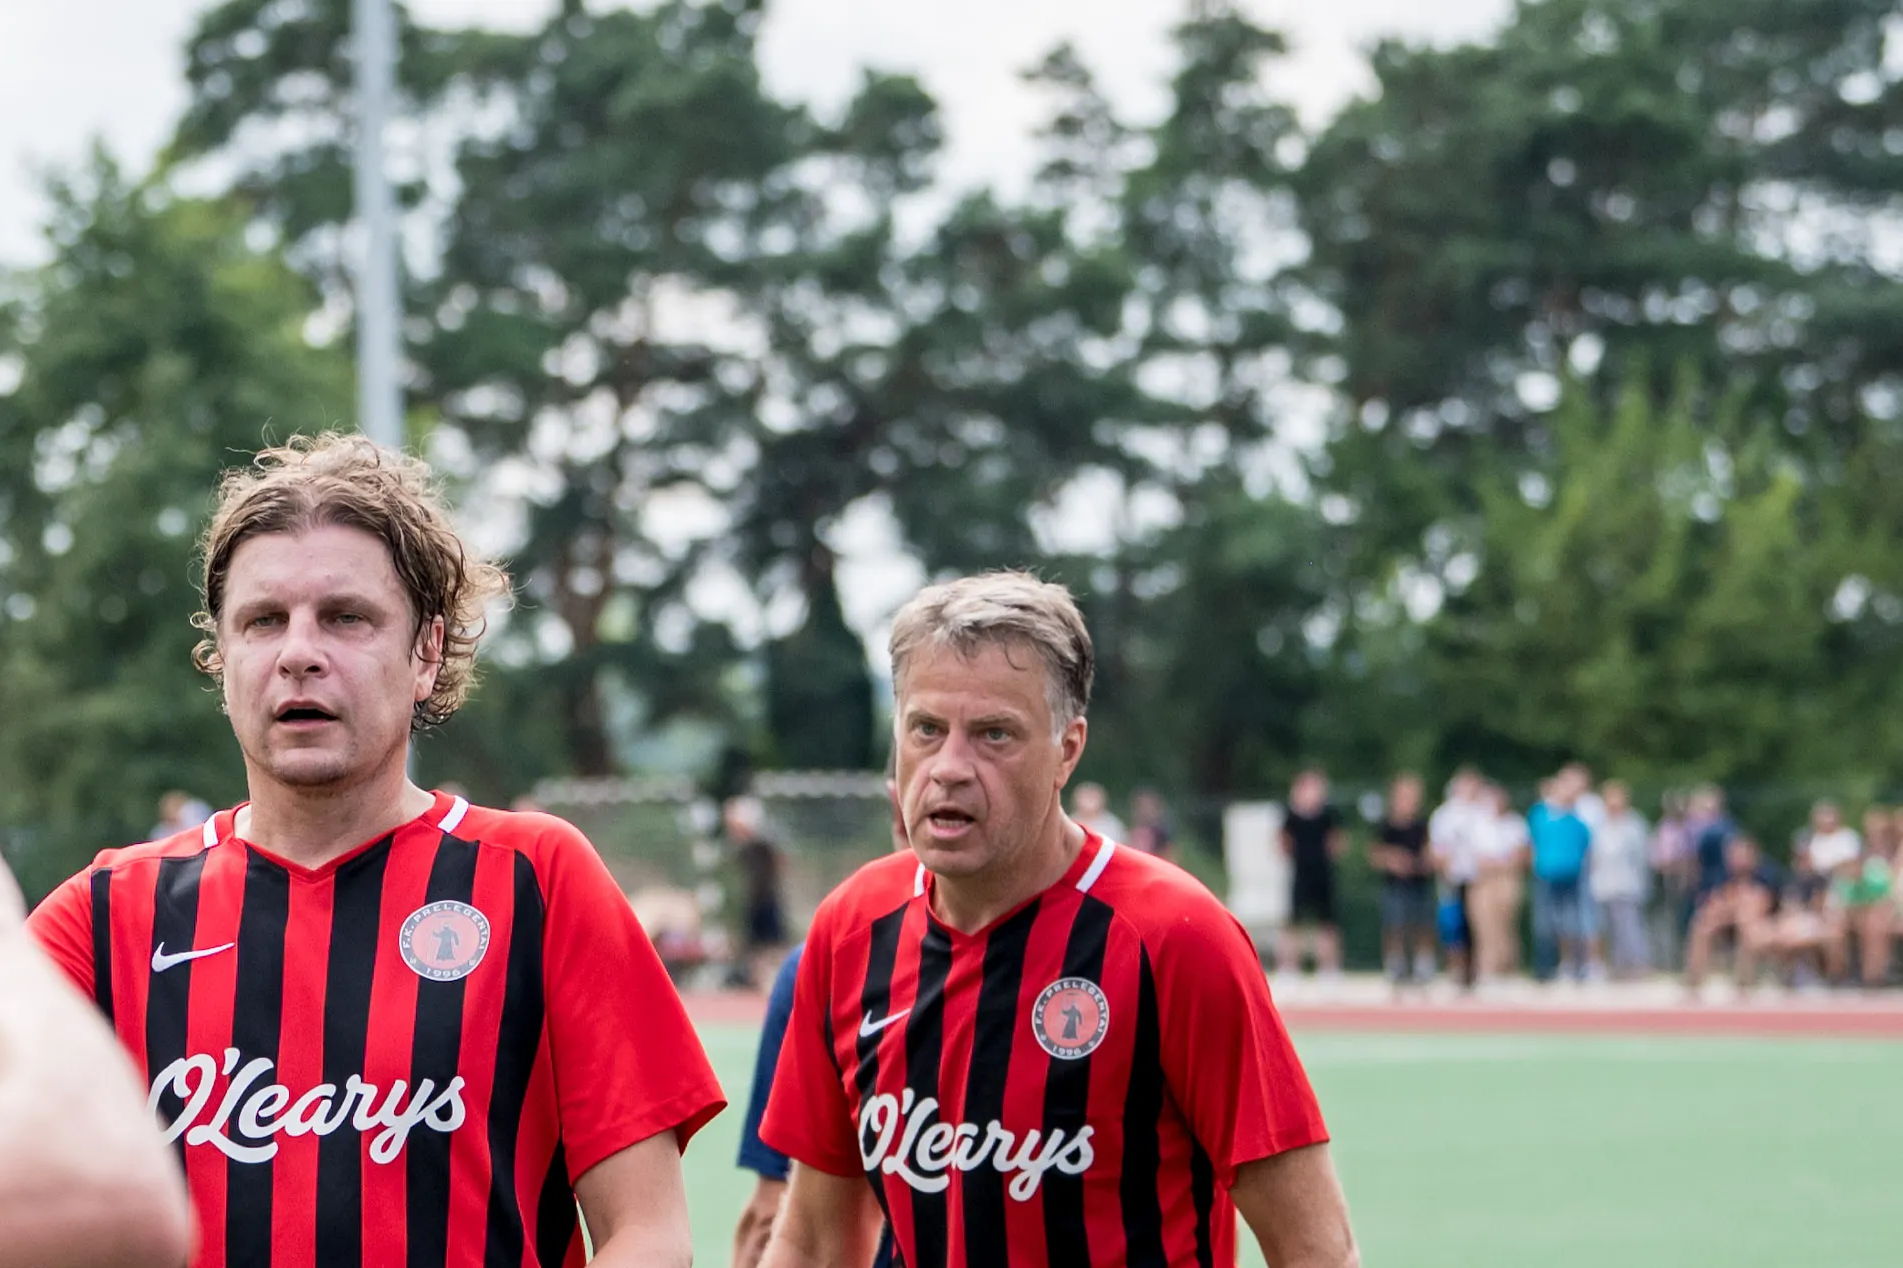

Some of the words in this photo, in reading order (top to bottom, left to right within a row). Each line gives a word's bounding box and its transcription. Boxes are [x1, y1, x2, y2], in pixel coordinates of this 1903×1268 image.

[413, 903, 488, 950] PRELEGENTAI
[146, 1047, 466, 1164] O'Learys
[858, 1087, 1094, 1202] O'Learys
